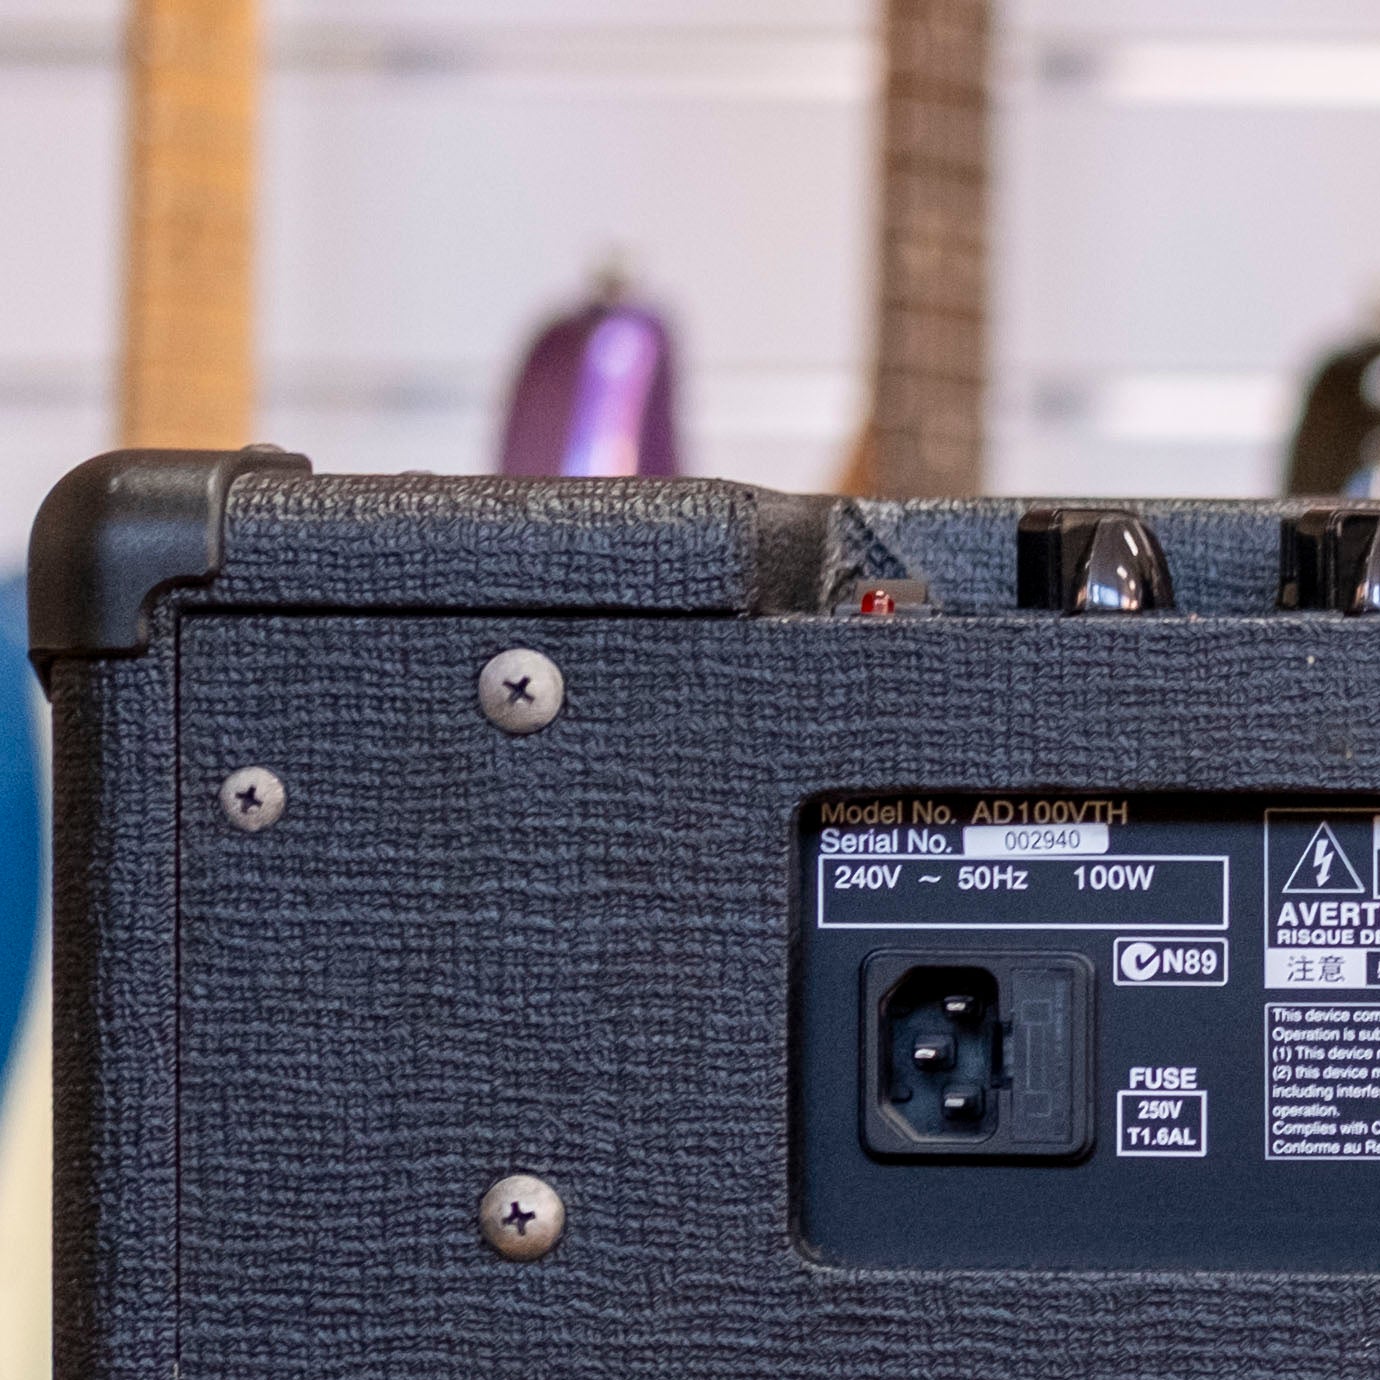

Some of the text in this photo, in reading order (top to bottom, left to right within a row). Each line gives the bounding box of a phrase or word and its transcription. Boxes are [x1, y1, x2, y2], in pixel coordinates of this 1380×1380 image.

[821, 799, 1129, 825] Model No. AD100VTH
[820, 829, 1082, 855] Serial No. 002940
[833, 864, 902, 891] 240V
[957, 864, 1029, 891] 50Hz
[1073, 864, 1155, 891] 100W
[1275, 926, 1355, 947] RISQUE
[1161, 950, 1217, 976] N89
[1285, 954, 1347, 984] 注意
[1271, 1026, 1341, 1042] Operation
[1342, 1026, 1356, 1042] is
[1128, 1067, 1198, 1090] FUSE
[1136, 1100, 1182, 1120] 250V
[1126, 1126, 1197, 1147] T1.6AL
[1271, 1121, 1337, 1137] Complies
[1339, 1121, 1369, 1137] with
